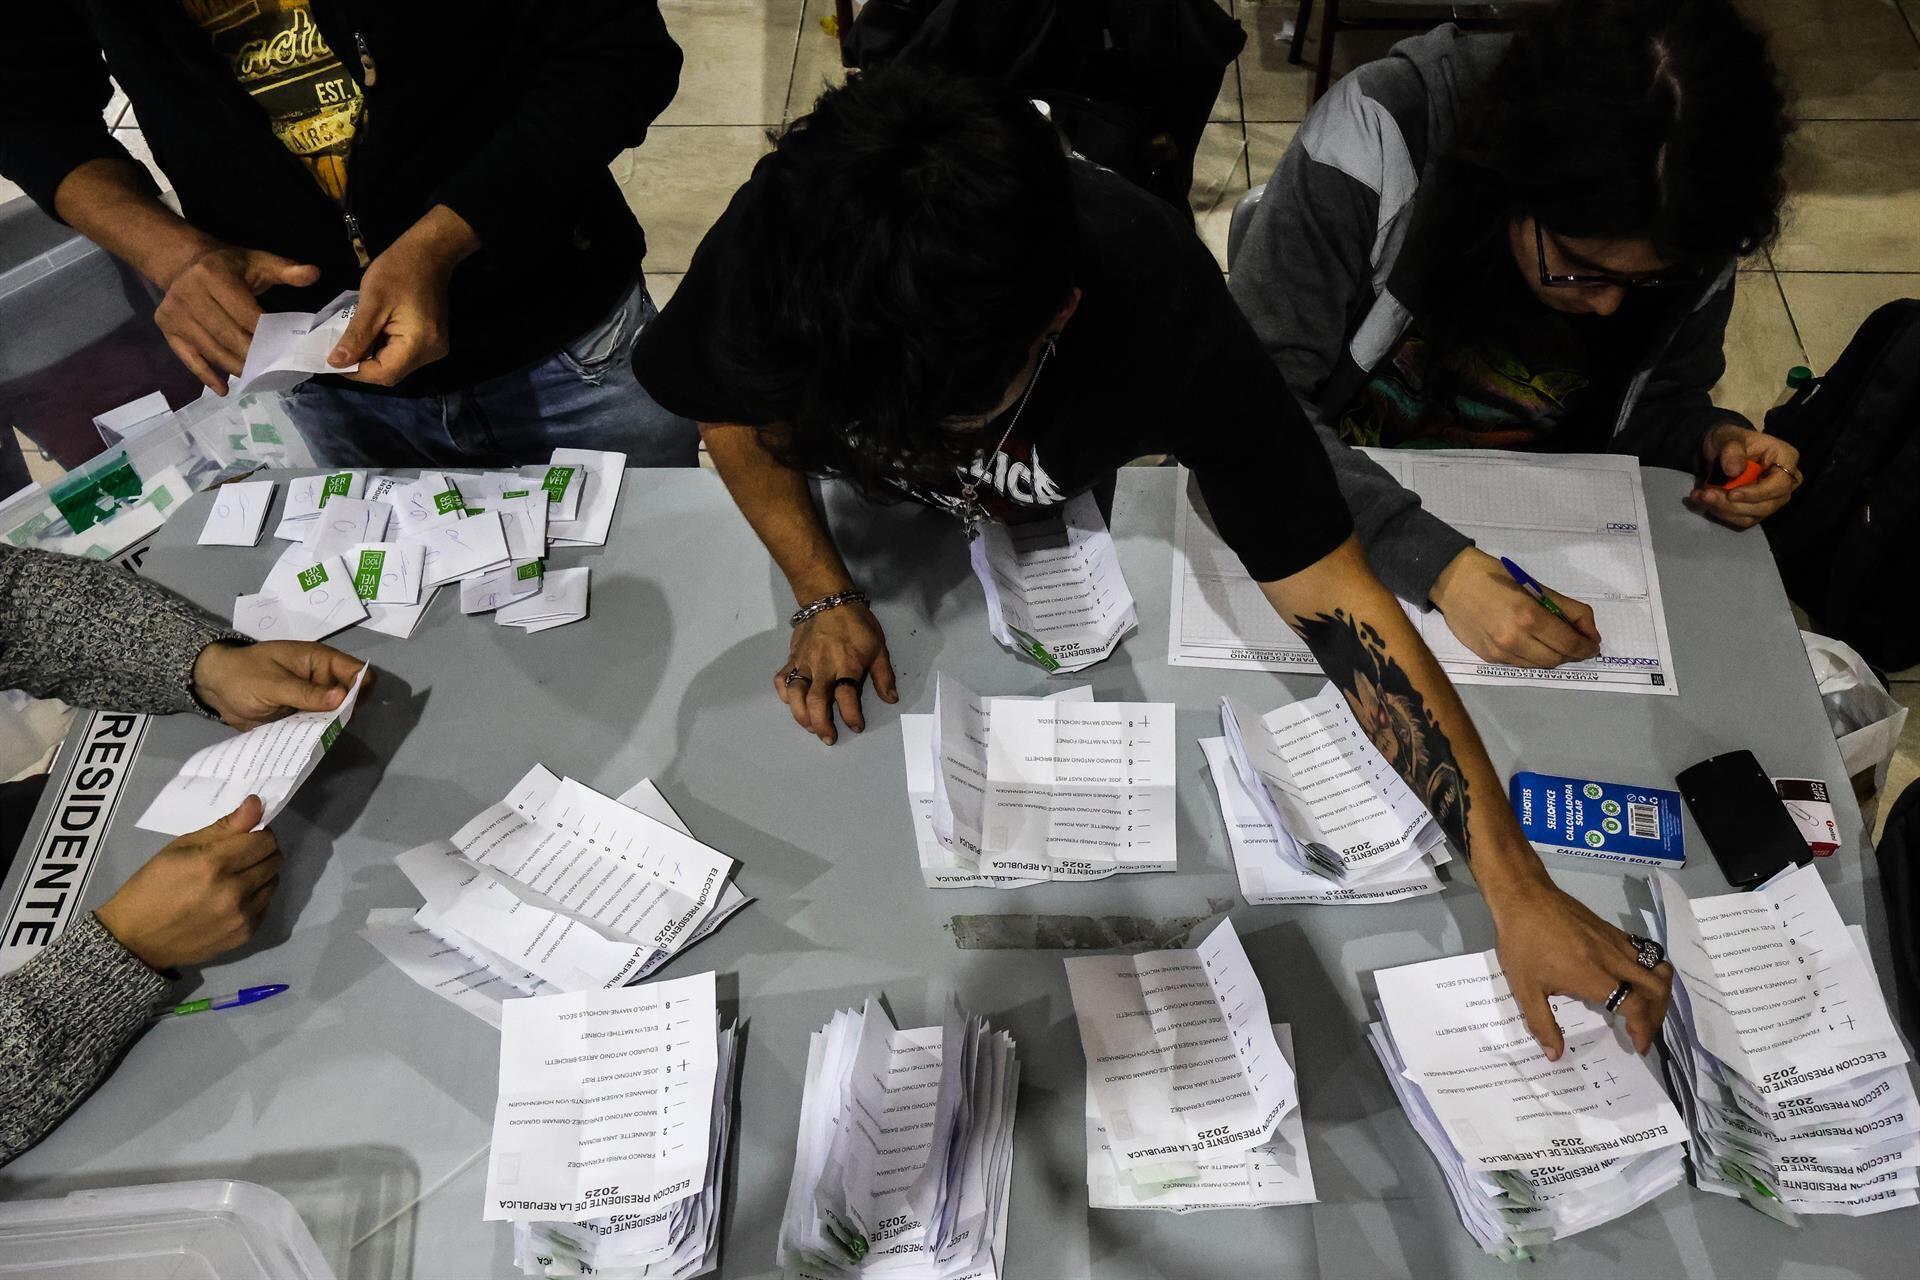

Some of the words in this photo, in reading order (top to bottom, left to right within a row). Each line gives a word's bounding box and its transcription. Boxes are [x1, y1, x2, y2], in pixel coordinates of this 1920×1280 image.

[315, 78, 352, 104] EST.
[551, 469, 569, 477] SER
[329, 477, 346, 486] SER
[550, 476, 565, 486] VEL
[328, 485, 343, 493] VEL
[304, 564, 321, 577] VEL
[305, 573, 323, 587] SER
[361, 574, 376, 585] VEL
[1053, 643, 1080, 653] 2025
[1059, 646, 1106, 659] PRESIDENTE
[1476, 670, 1534, 678] ESCRUTINIO
[1128, 758, 1133, 766] 6
[1548, 789, 1556, 830] SELLOFFICE
[1566, 784, 1574, 841] CALCULADORA
[1576, 800, 1584, 827] SOLAR
[10, 715, 137, 947] RESIDENTE
[1342, 841, 1372, 855] 2025
[1352, 838, 1400, 862] PRESIDENTE
[1556, 849, 1626, 862] CALCULADORA
[1629, 858, 1662, 866] SOLAR
[992, 861, 1040, 871] REPUBLICA
[1041, 864, 1052, 872] LA
[1053, 866, 1065, 874] DE
[1061, 861, 1091, 869] 2025
[1067, 866, 1117, 875] PRESIDENTE
[696, 867, 718, 907] ELECCION
[1385, 885, 1428, 896] ELECCION
[1332, 892, 1385, 900] PRESIDENTE
[664, 905, 700, 944] PRESIDENTE
[654, 919, 676, 943] 2025
[632, 946, 643, 957] LA
[603, 958, 636, 989] REPUBLIC
[633, 1003, 658, 1013] HAROLD
[665, 1001, 671, 1009] 8
[558, 1013, 578, 1021] SECUL
[579, 1008, 632, 1018] MAYNE-NICHOLLS
[634, 1025, 659, 1034] EVELYN
[666, 1023, 671, 1031] 7
[607, 1029, 634, 1037] MATTHEI
[628, 1046, 658, 1056] EDUARDO
[666, 1044, 671, 1052] 6
[578, 1054, 599, 1062] ARTES
[599, 1051, 628, 1060] ANTONIO
[544, 1057, 579, 1065] BRICHETTI
[1835, 1051, 1887, 1072] ELECCION
[643, 1067, 659, 1076] JOSE
[666, 1066, 671, 1074] 5
[1763, 1066, 1798, 1084] 2025
[614, 1071, 642, 1080] ANTONIO
[1772, 1066, 1834, 1091] PRESIDENTE
[625, 1089, 658, 1098] JOHANNES
[1758, 1085, 1771, 1094] DE
[1850, 1081, 1890, 1108] ELECCION
[601, 1093, 624, 1101] KAISER
[1777, 1097, 1814, 1109] 2025
[663, 1106, 668, 1114] 3
[1787, 1100, 1850, 1117] PRESIDENTE
[542, 1116, 604, 1125] ENRIQUEZ-OMINAMI
[604, 1112, 633, 1121] ANTONIO
[1262, 1099, 1285, 1132] ELECCION
[1771, 1110, 1786, 1121] DE
[1854, 1113, 1904, 1135] ELECCION
[620, 1131, 656, 1139] JEANNETTE
[663, 1127, 668, 1136] 2
[1197, 1126, 1230, 1140] 2025
[1619, 1125, 1668, 1145] ELECCION
[578, 1138, 602, 1147] ROMAN
[602, 1134, 618, 1142] JARA
[1205, 1127, 1261, 1148] PRESIDENTE
[1551, 1138, 1583, 1147] 2025
[1178, 1144, 1191, 1152] LA
[1191, 1141, 1205, 1152] DE
[1561, 1139, 1620, 1156] PRESIDENTE
[1127, 1145, 1178, 1159] REPUBLICA
[1532, 1150, 1547, 1158] LA
[1547, 1148, 1561, 1157] DE
[1478, 1152, 1533, 1163] REPUBLICA
[1781, 1156, 1818, 1164] 2025
[567, 1158, 605, 1168] FERNANDEZ
[1856, 1152, 1902, 1174] ELECCION
[1790, 1164, 1854, 1174] PRESIDENTE
[1539, 1163, 1600, 1186] PRESIDENTE
[653, 1179, 690, 1202] ELECCION
[1782, 1180, 1847, 1191] PRESIDENTE
[585, 1186, 619, 1199] 2025
[499, 1200, 557, 1211] REPUBLICA
[589, 1194, 651, 1208] PRESIDENTE
[559, 1203, 572, 1211] LA
[575, 1201, 587, 1212] DE
[613, 1212, 667, 1230] PRESIDENTE
[879, 1215, 907, 1230] 2025
[600, 1226, 612, 1236] DE
[871, 1232, 882, 1242] DE
